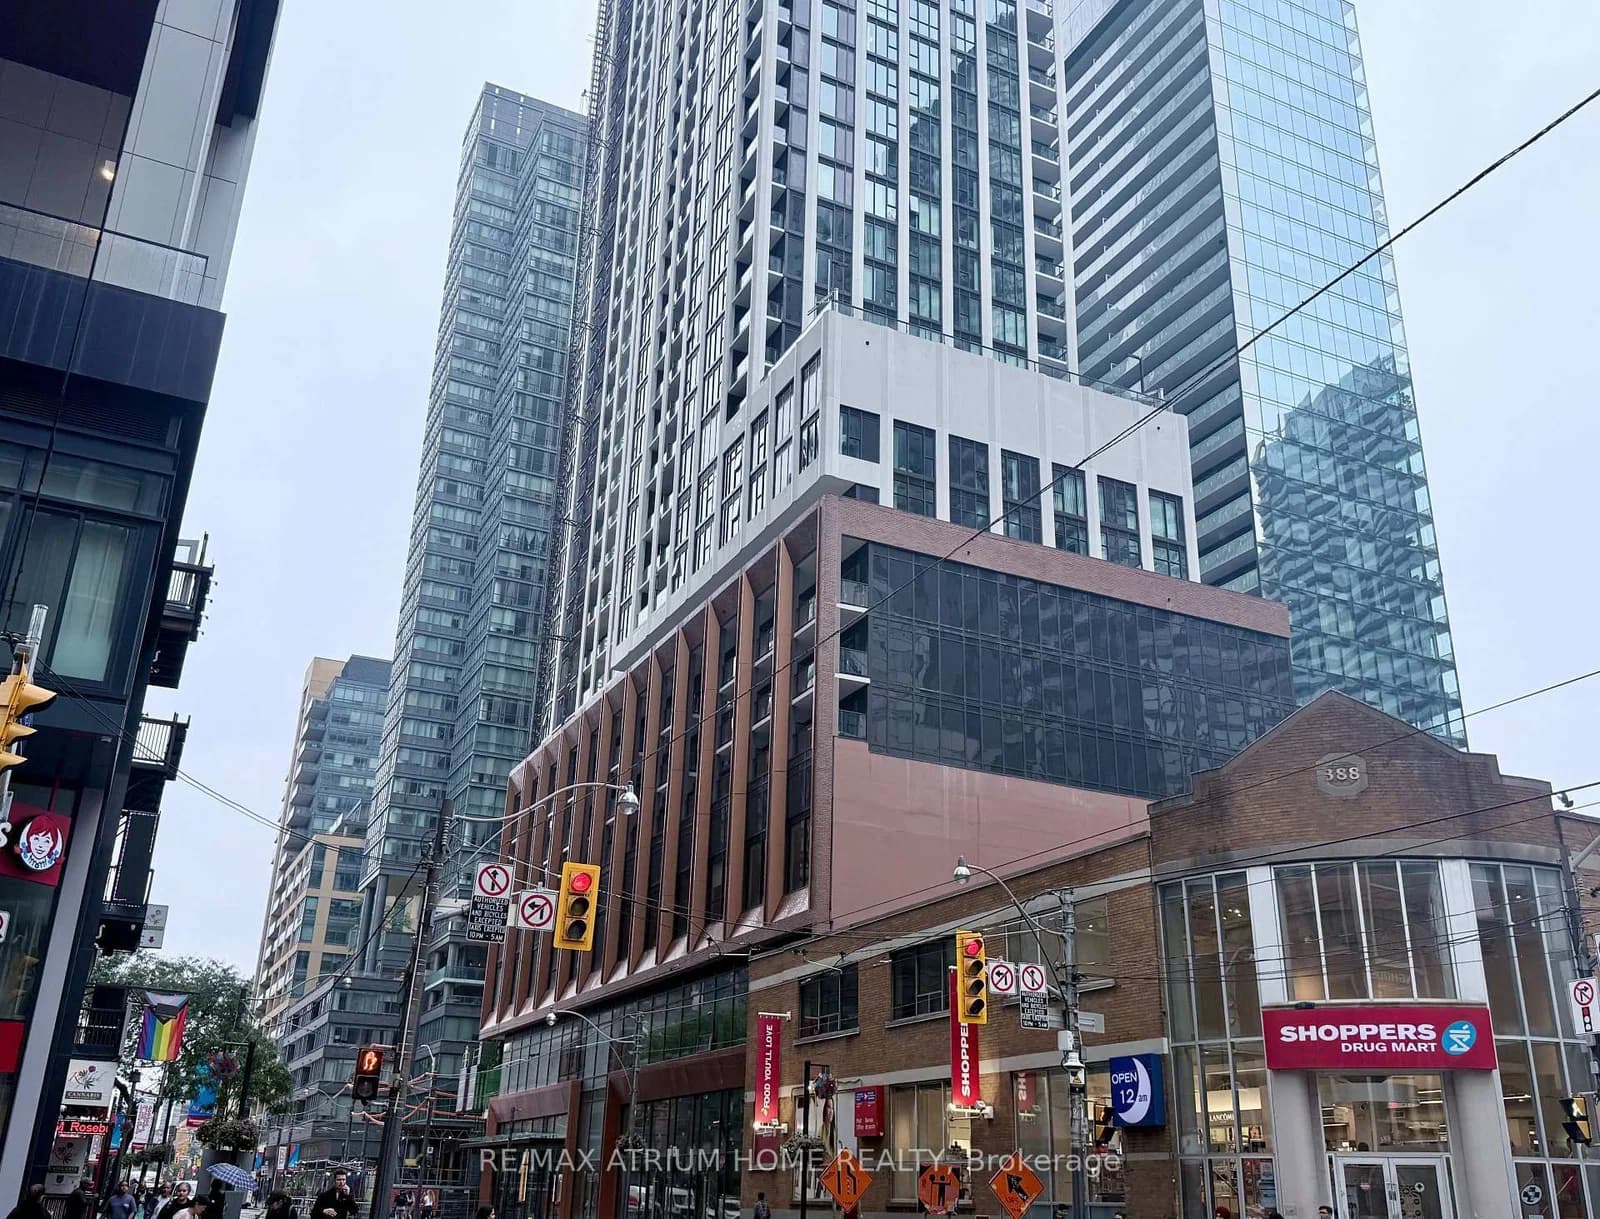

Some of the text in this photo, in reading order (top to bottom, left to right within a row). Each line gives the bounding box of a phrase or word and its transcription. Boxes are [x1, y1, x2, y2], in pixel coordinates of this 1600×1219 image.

[1325, 767, 1360, 781] 388
[477, 902, 503, 911] VEHICLES
[475, 917, 502, 925] EXCEPTED
[484, 911, 507, 919] BICYCLES
[1279, 1024, 1437, 1042] SHOPPERS
[1341, 1042, 1438, 1053] DRUG MART
[763, 1024, 774, 1109] FOOD YOU'LL LOVE
[960, 1022, 971, 1098] SHOPPE
[1111, 1072, 1138, 1085] OPEN
[1119, 1088, 1148, 1104] 12 am
